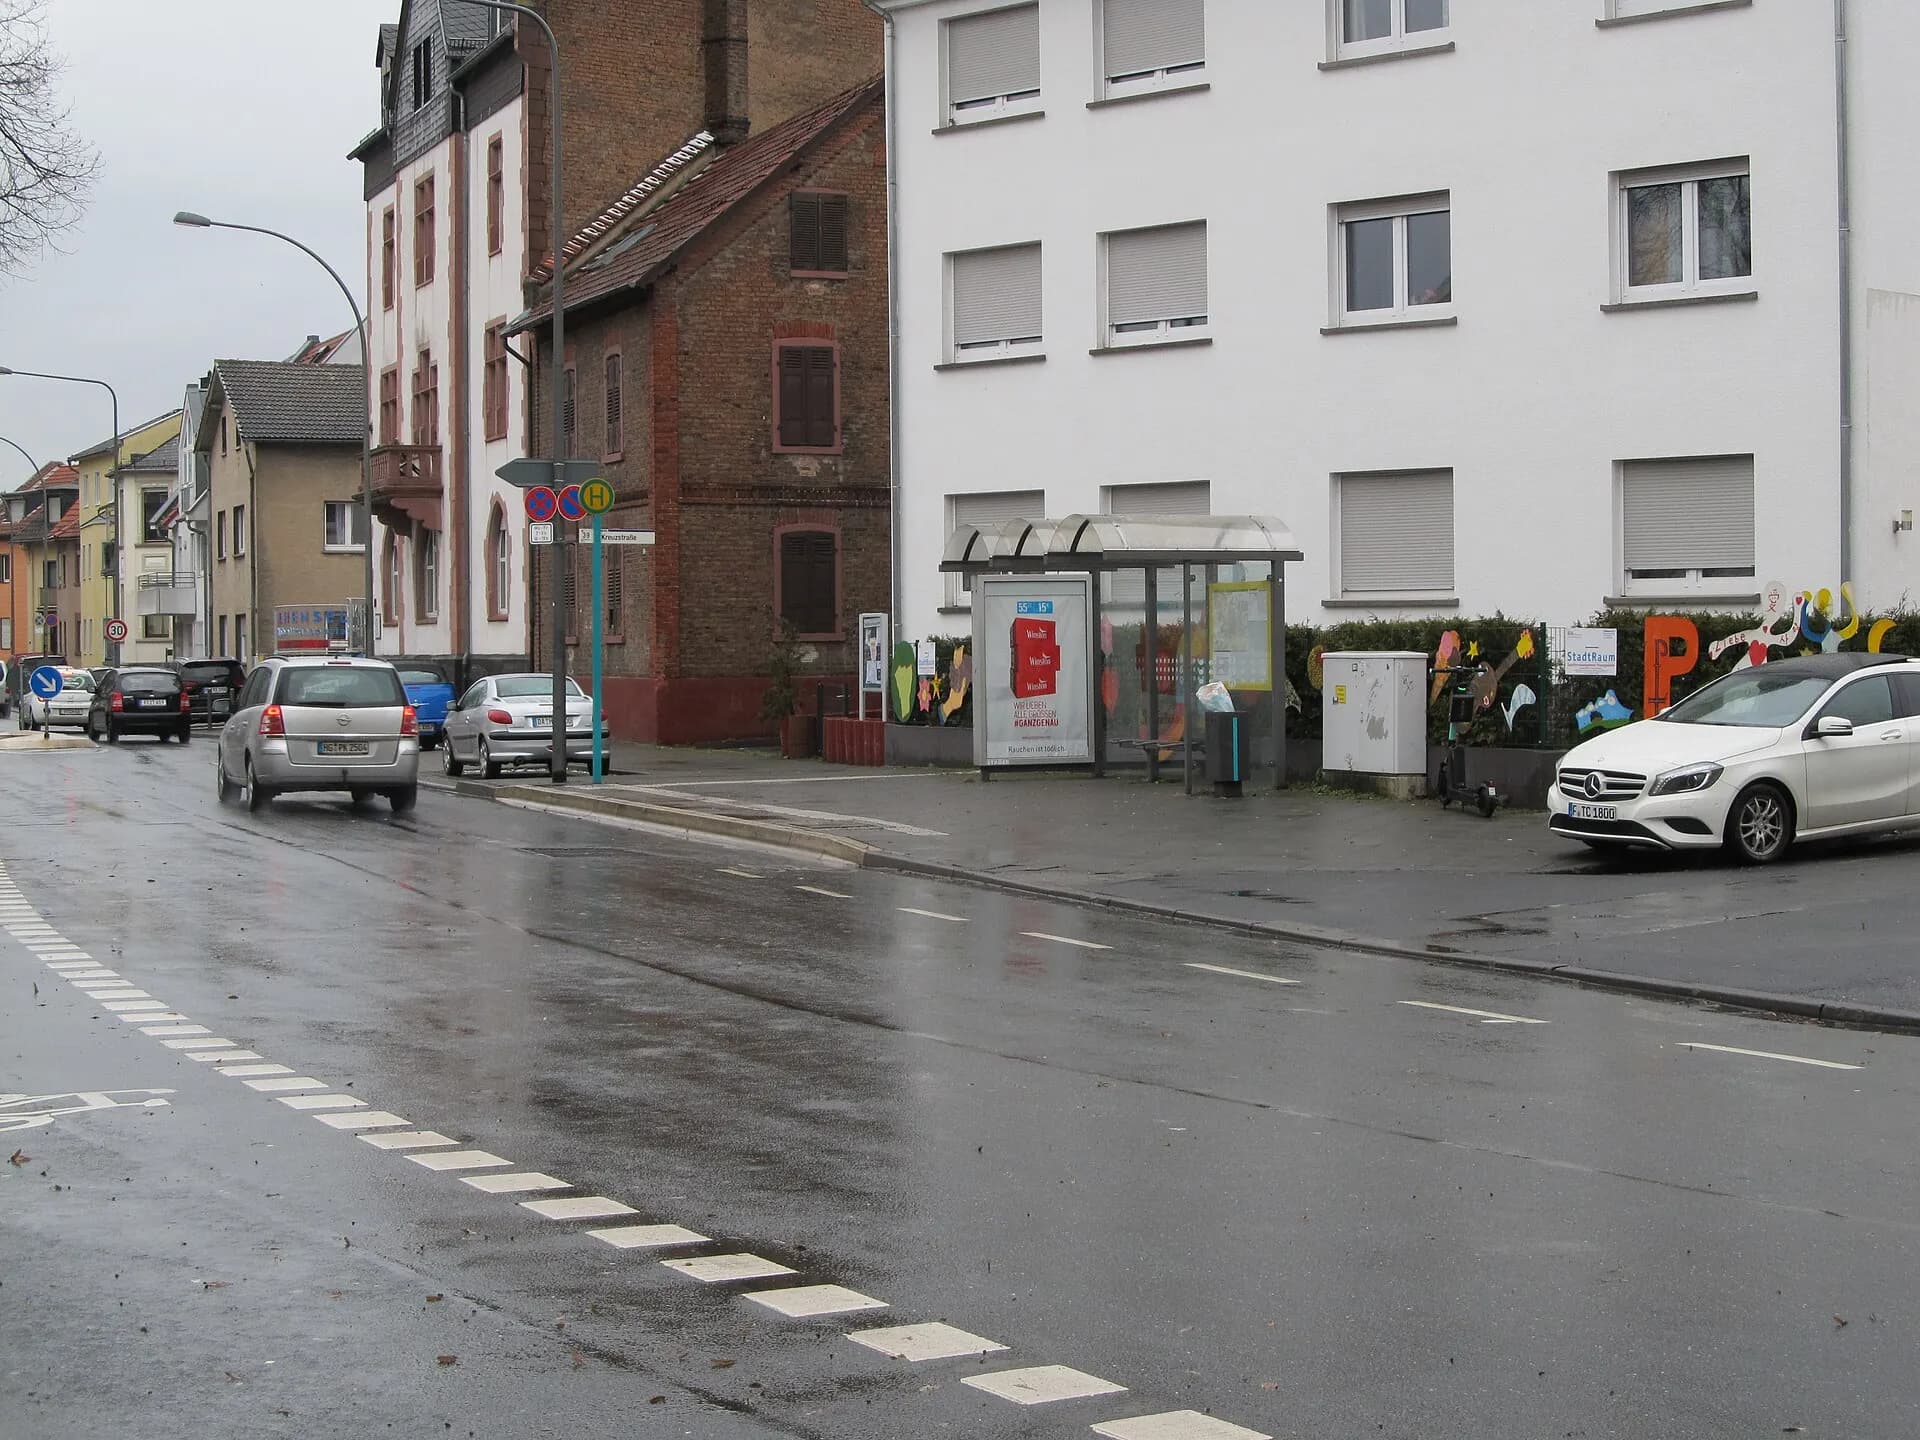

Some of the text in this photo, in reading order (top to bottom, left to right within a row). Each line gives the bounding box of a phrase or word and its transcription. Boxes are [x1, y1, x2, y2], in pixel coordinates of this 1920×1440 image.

[590, 487, 604, 506] H
[601, 533, 637, 541] Kreuzstraße
[110, 626, 123, 636] 30
[1026, 629, 1048, 639] Winston
[1029, 655, 1051, 666] Winston
[1567, 651, 1616, 662] StadtRaum
[1026, 681, 1048, 691] Winston
[1014, 700, 1047, 710] WIR LIEBEN
[1014, 710, 1027, 719] ALLE
[1014, 719, 1059, 727] #GANZGENAU
[1008, 745, 1034, 753] Rauchen
[1573, 805, 1614, 819] F TC 1800
